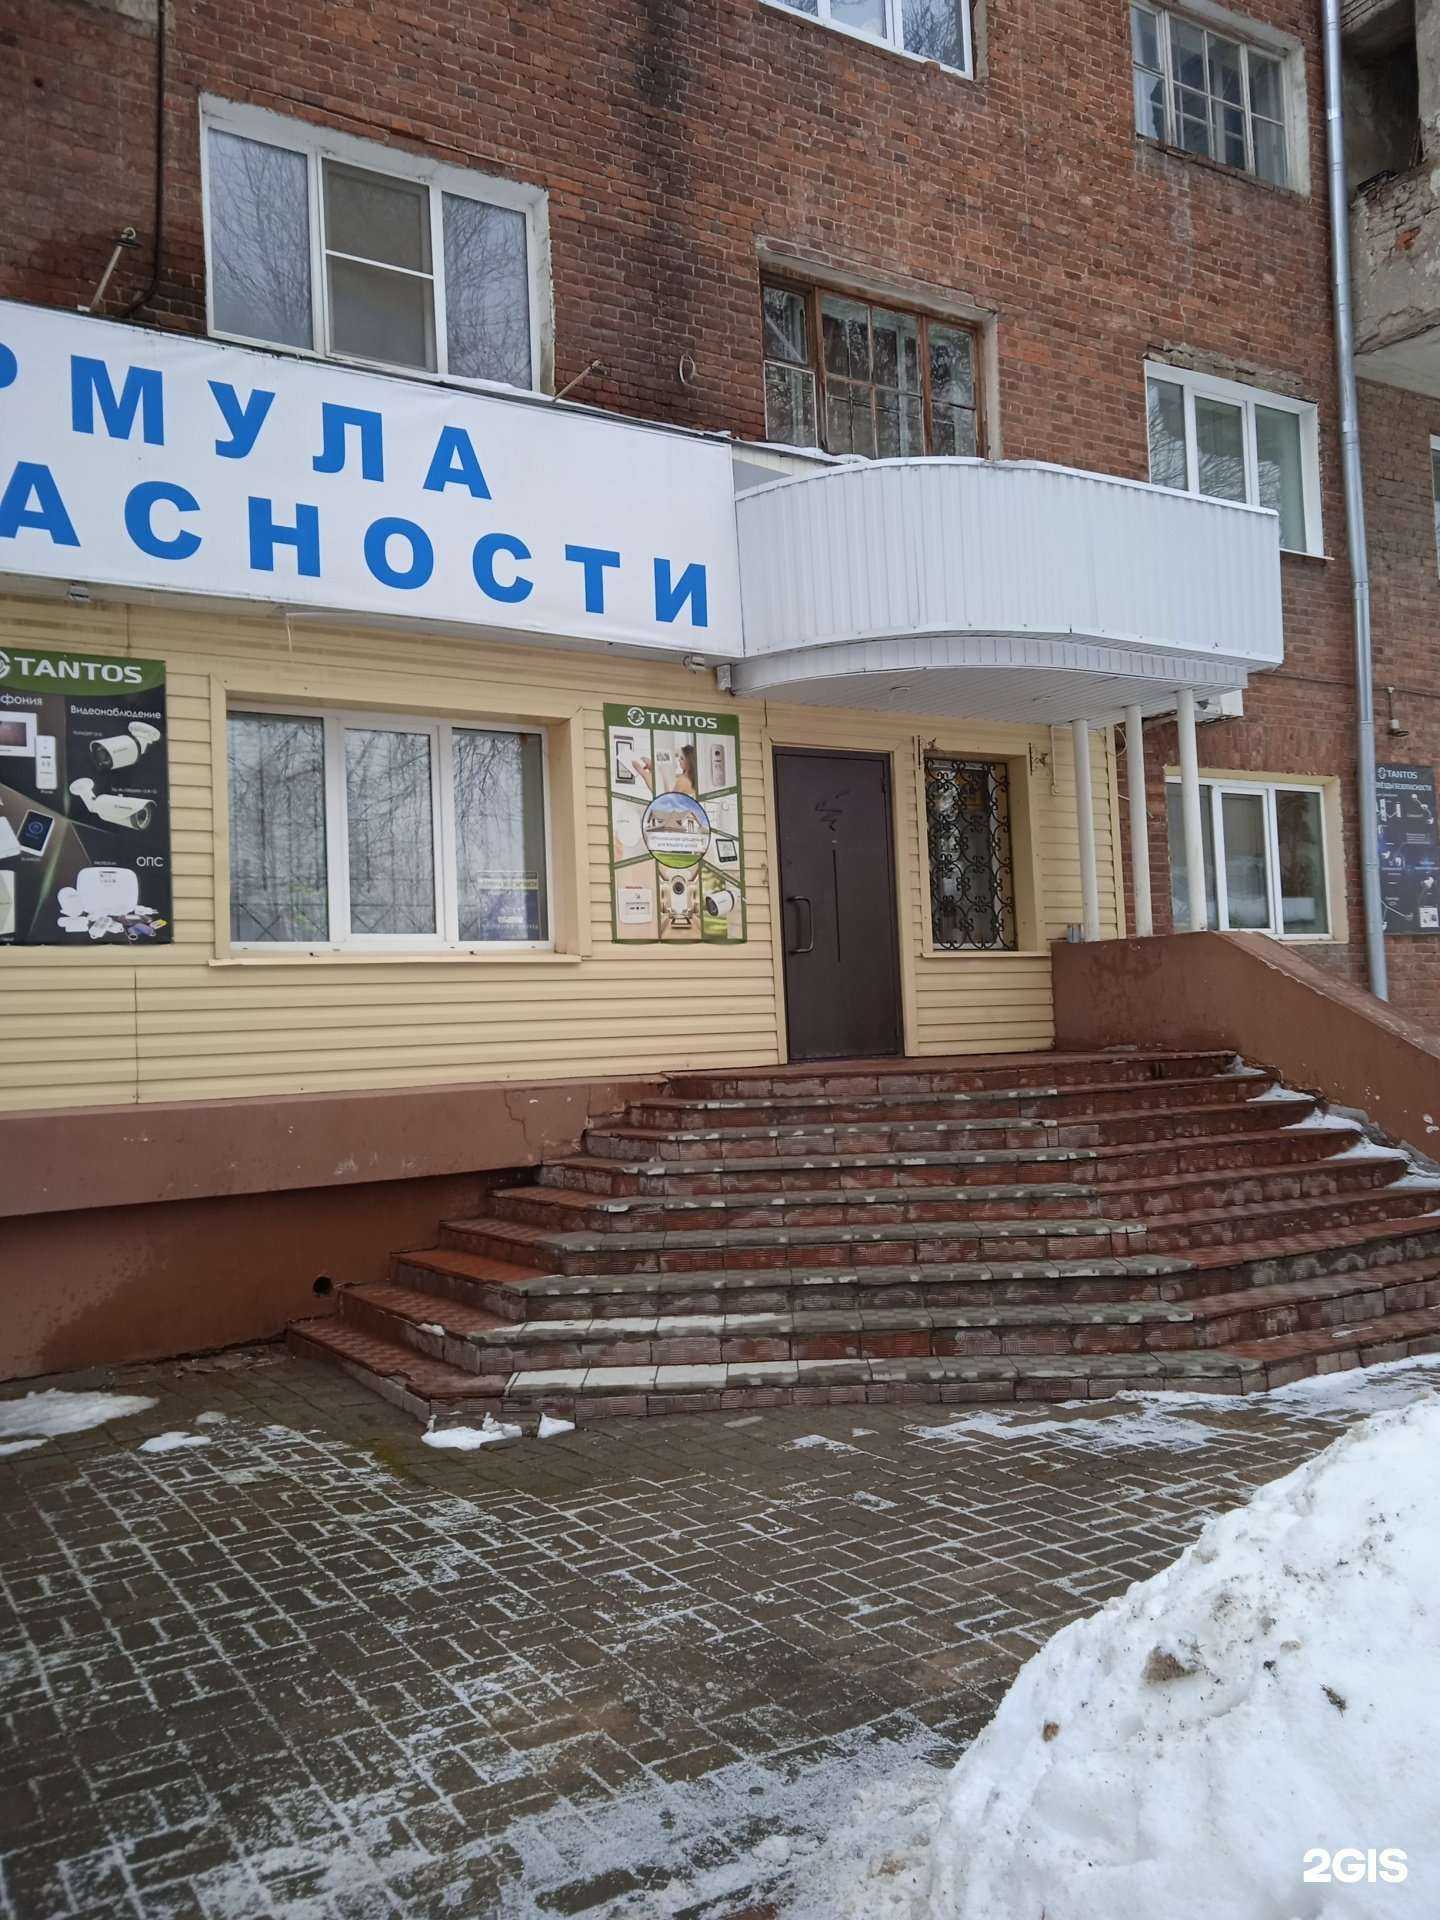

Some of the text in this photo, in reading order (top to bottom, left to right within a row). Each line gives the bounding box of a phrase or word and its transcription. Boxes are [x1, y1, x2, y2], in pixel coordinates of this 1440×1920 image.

[0, 460, 709, 628] АСНОСТИ
[14, 656, 143, 684] TANTOS
[0, 692, 43, 706] фония
[70, 704, 161, 719] Видеонаблюдение
[646, 711, 718, 729] TANTOS
[1386, 769, 1418, 779] TANTOS
[136, 856, 164, 867] ОПС
